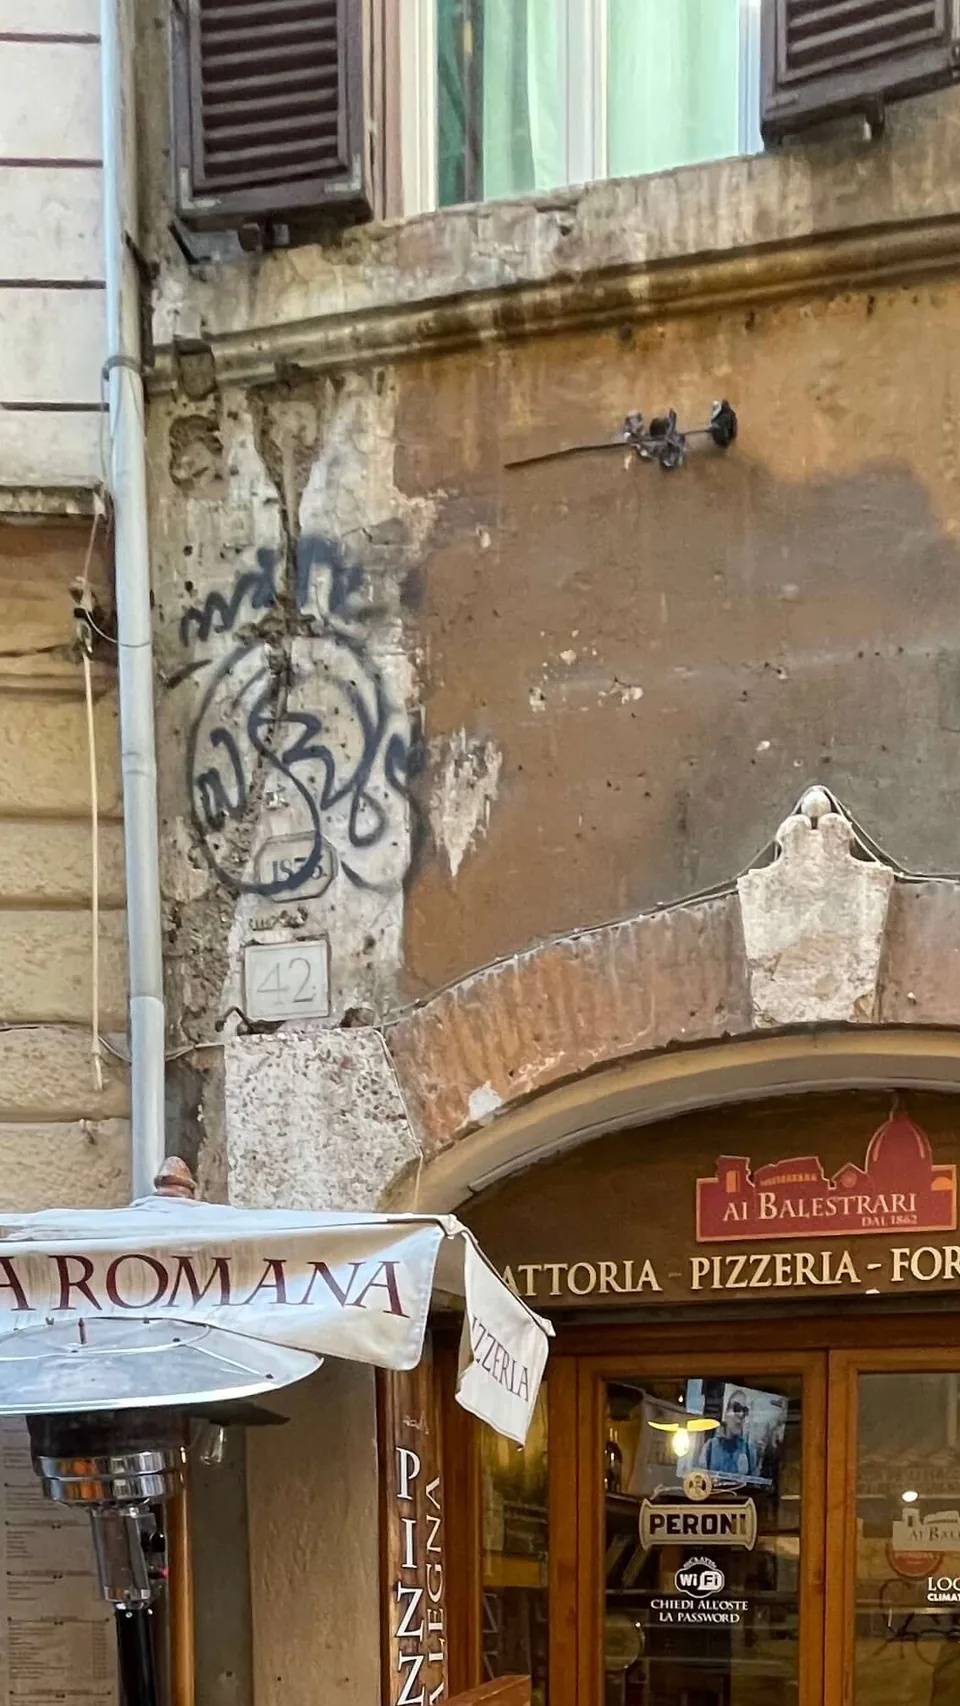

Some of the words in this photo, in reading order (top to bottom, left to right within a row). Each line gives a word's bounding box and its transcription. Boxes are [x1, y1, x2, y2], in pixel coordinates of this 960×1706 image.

[723, 1202, 748, 1221] AI
[758, 1193, 917, 1220] BALESTRARI
[862, 1216, 887, 1227] DAL
[501, 1259, 662, 1297] ATTORIA
[690, 1250, 862, 1290] PIZZERIA
[650, 1514, 746, 1535] PERONI
[650, 1599, 694, 1610] CHIEDI
[659, 1612, 674, 1622] LA
[677, 1612, 740, 1623] PASSWORD
